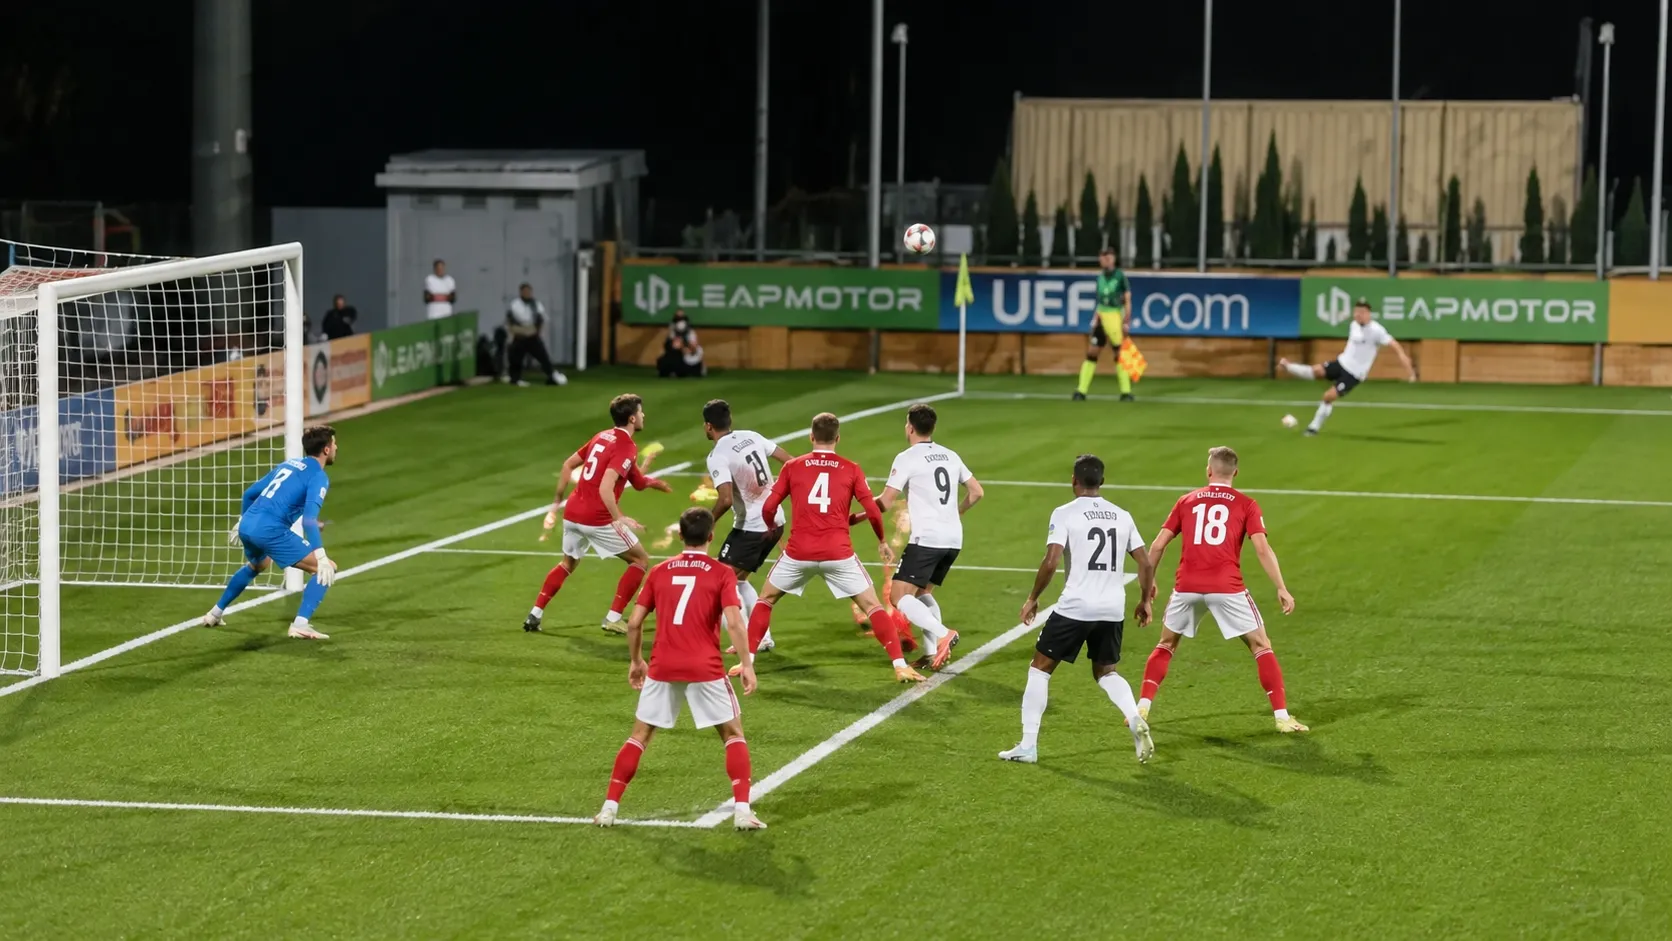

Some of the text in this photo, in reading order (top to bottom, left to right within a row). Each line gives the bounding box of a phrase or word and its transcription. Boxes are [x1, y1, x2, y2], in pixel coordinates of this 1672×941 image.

[677, 284, 922, 311] LEAPMOTOR
[992, 278, 1250, 330] UEF.com
[583, 443, 605, 481] 5
[807, 472, 831, 514] 4
[934, 467, 951, 505] 9
[1192, 503, 1229, 546] 18
[1087, 527, 1117, 571] 21
[671, 575, 697, 626] 7
